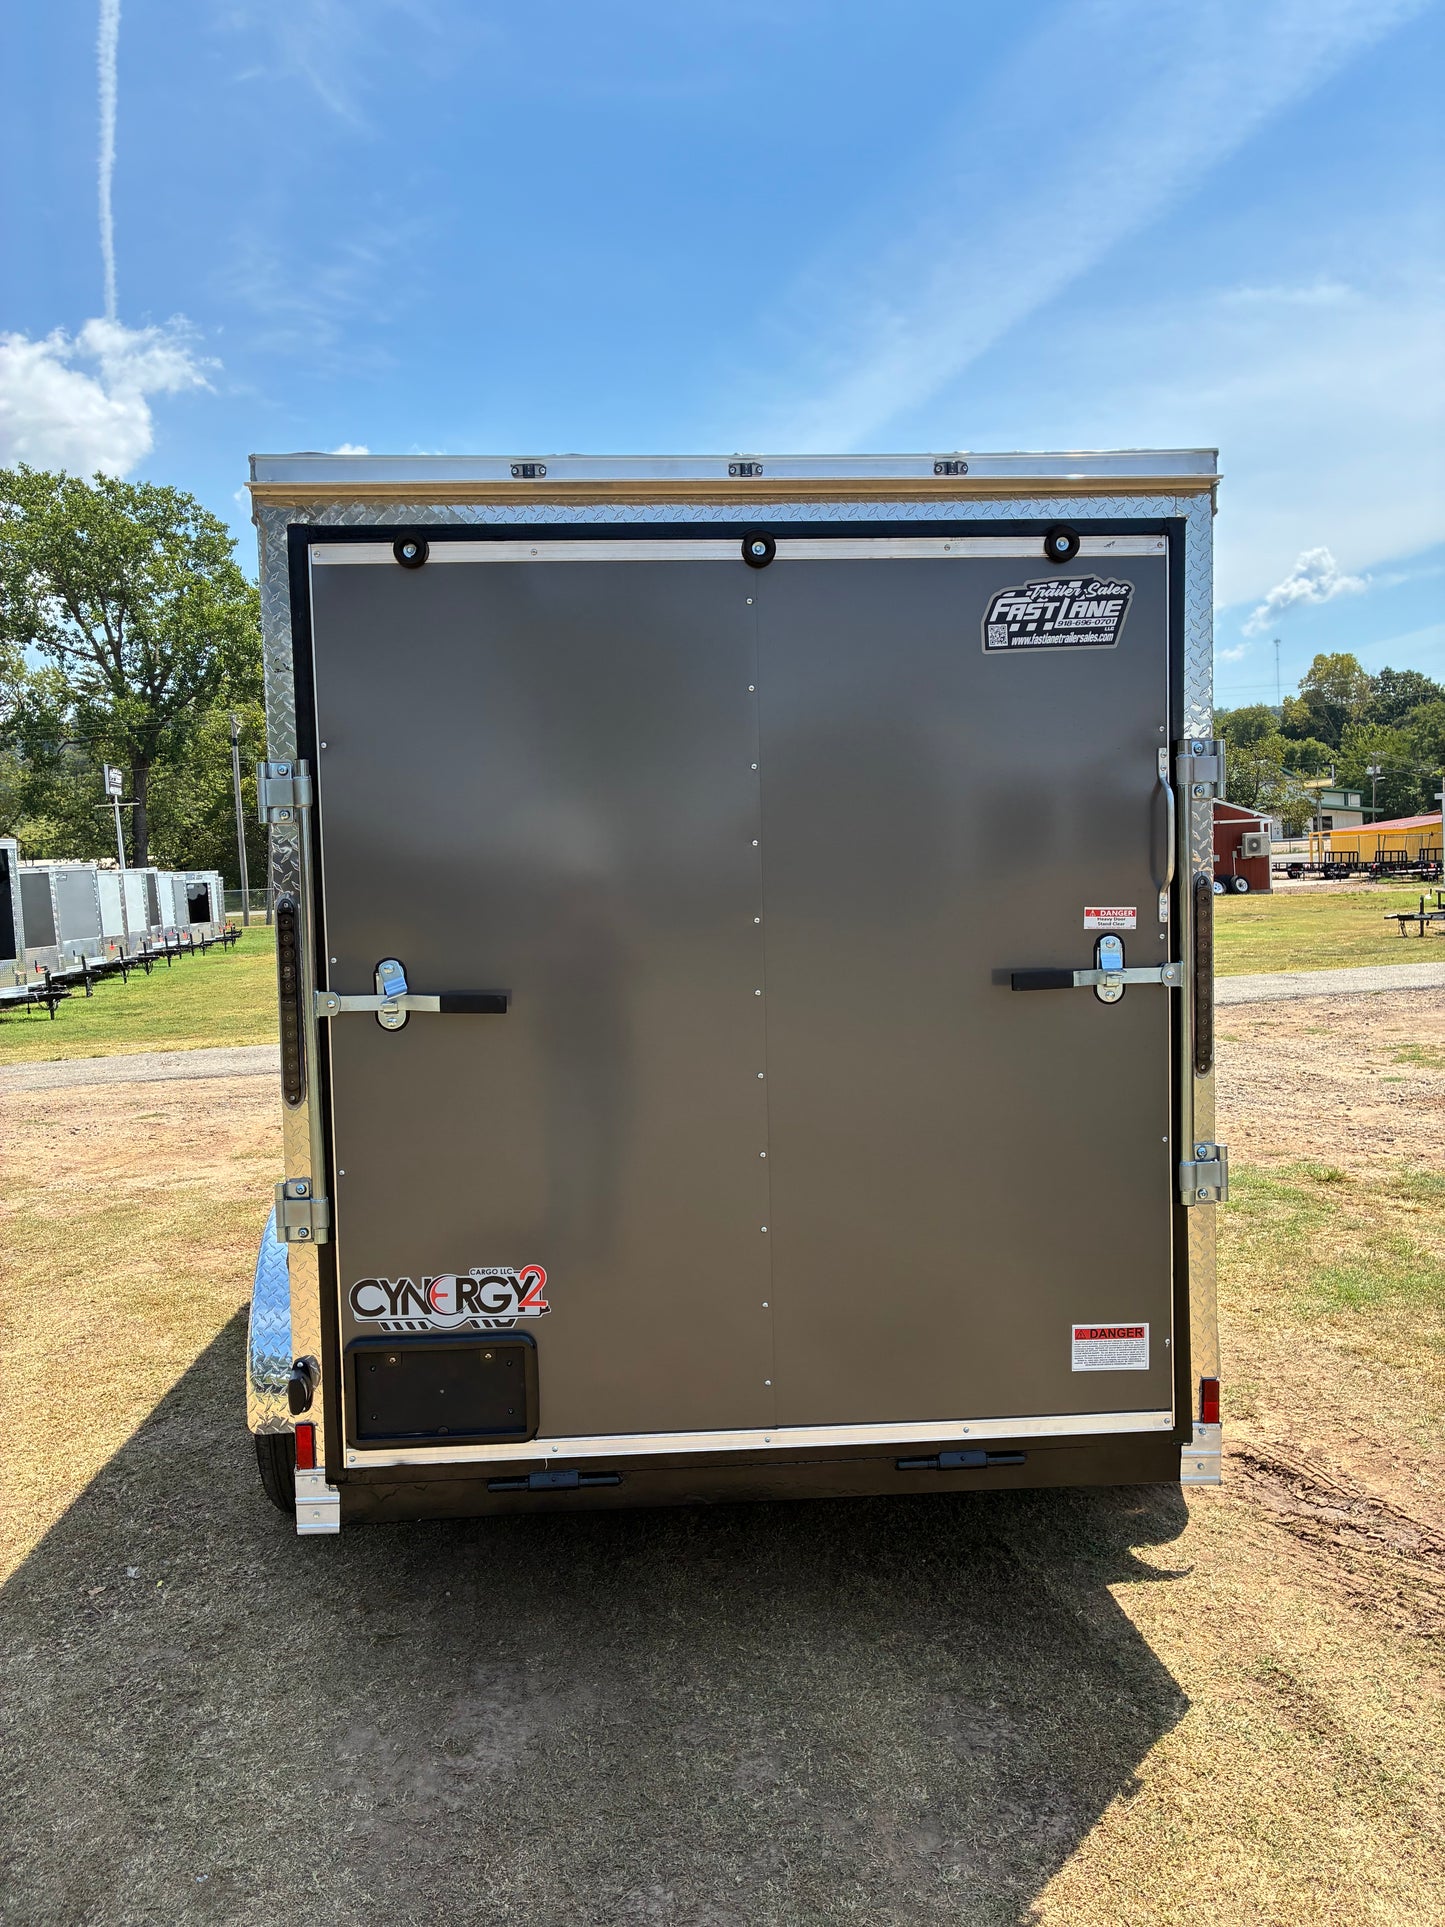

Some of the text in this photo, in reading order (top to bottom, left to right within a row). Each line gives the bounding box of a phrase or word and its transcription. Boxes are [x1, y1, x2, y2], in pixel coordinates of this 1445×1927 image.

[1030, 582, 1130, 600] Trailer Sales
[1058, 618, 1116, 627] 918-696-0701
[1011, 631, 1114, 646] www.fastlanetrailersales.com
[469, 1267, 513, 1276] CARGO LLC
[1089, 1327, 1143, 1339] DANGER
